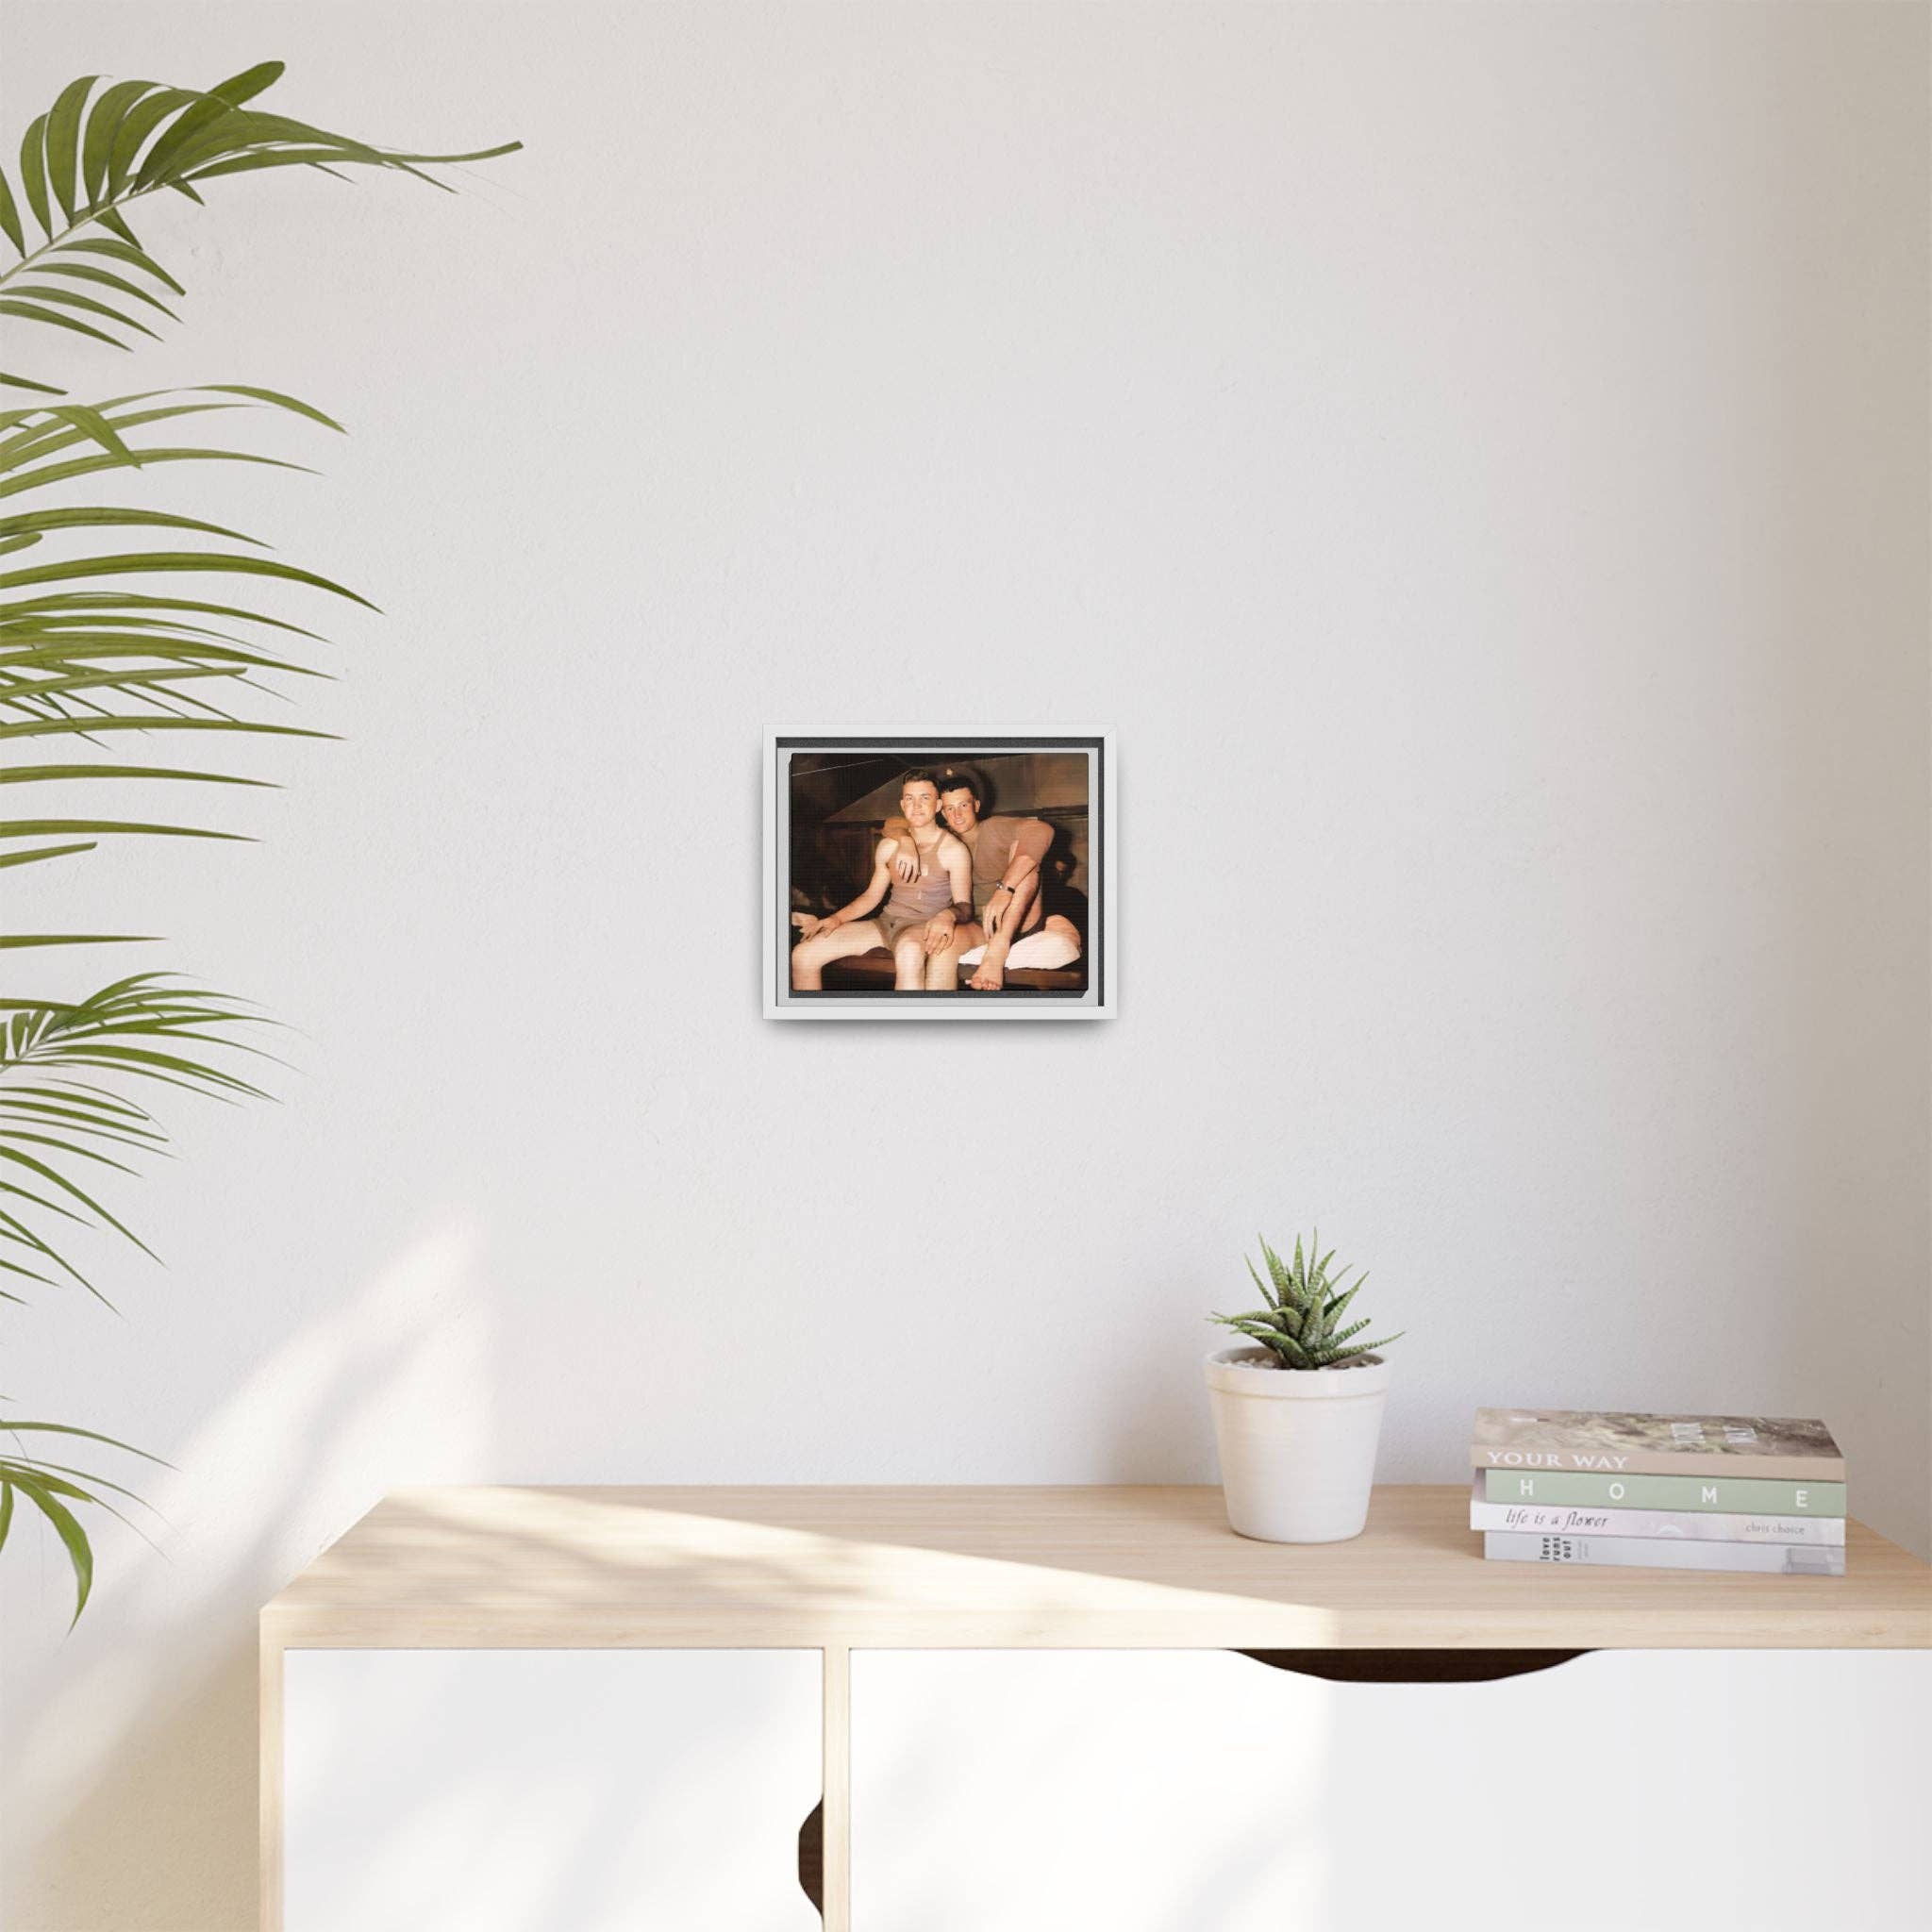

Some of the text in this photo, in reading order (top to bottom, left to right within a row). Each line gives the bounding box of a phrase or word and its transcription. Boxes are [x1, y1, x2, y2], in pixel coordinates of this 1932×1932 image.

[1487, 1451, 1629, 1470] YOUR WAY
[1520, 1478, 1808, 1507] HOME
[1505, 1508, 1609, 1531] life is a flower
[1745, 1523, 1770, 1534] chris
[1540, 1537, 1550, 1559] love
[1553, 1537, 1561, 1561] runs
[1562, 1540, 1572, 1559] out
